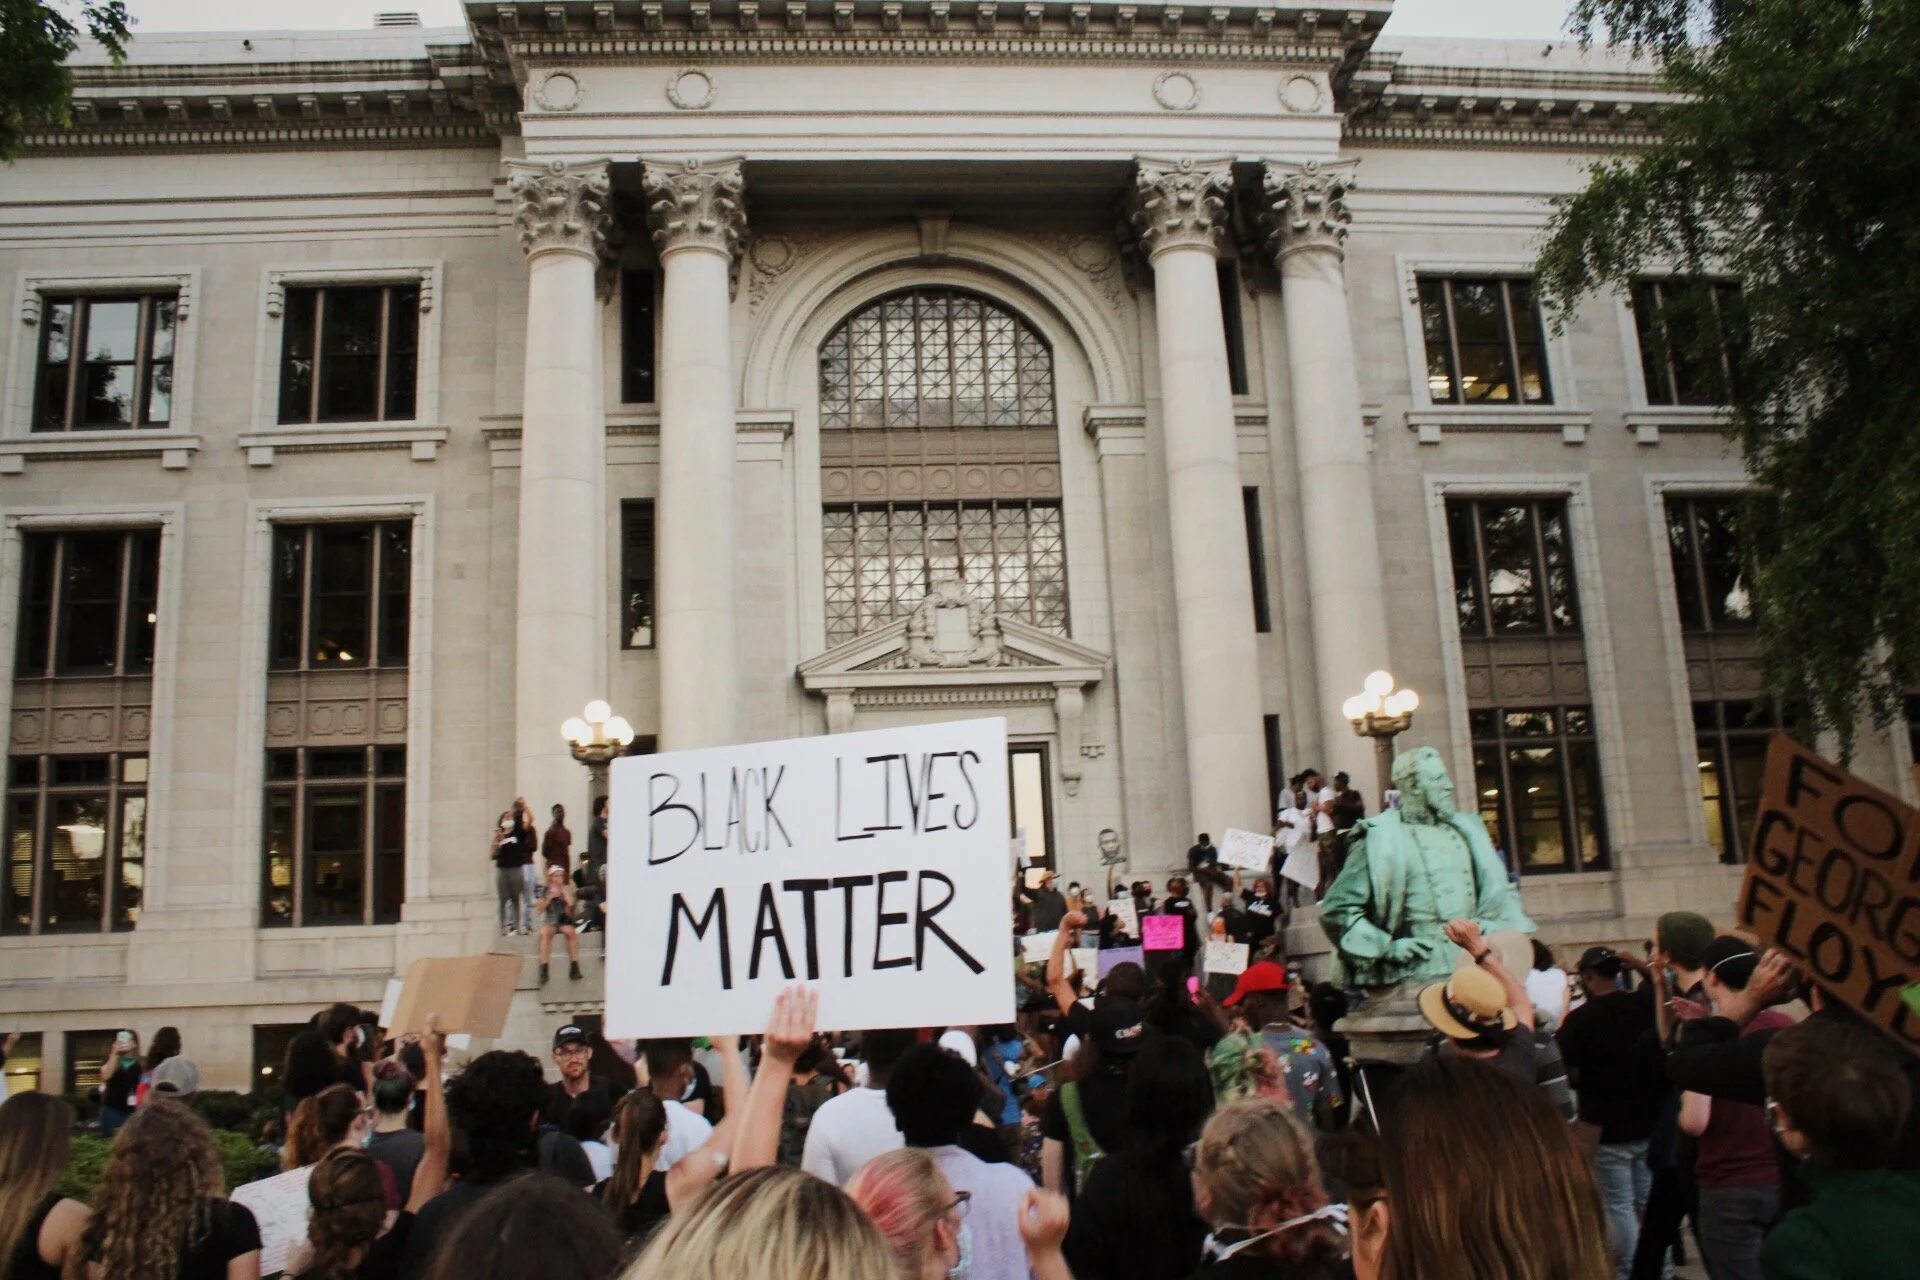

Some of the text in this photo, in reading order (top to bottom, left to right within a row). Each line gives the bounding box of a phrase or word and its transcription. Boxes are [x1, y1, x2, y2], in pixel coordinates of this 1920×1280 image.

[647, 750, 981, 866] BLACK LIVES
[1788, 753, 1920, 883] FO
[660, 869, 986, 990] MATTER
